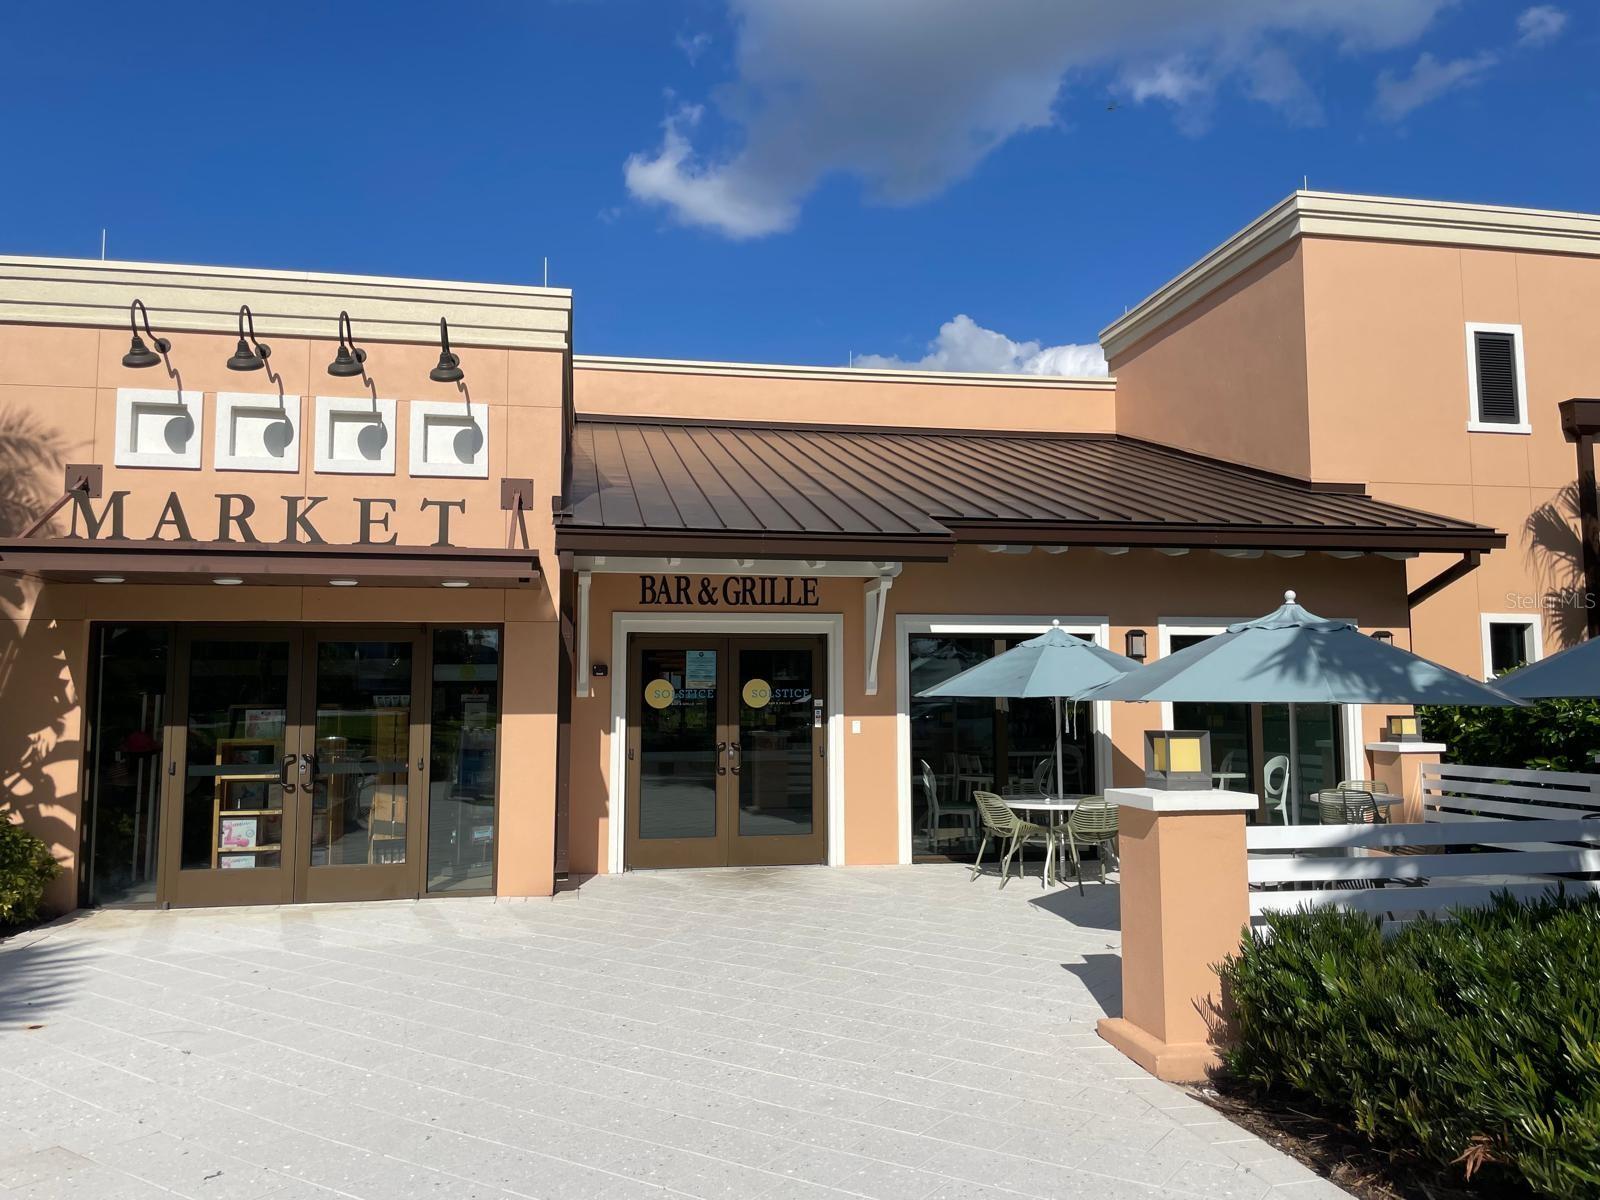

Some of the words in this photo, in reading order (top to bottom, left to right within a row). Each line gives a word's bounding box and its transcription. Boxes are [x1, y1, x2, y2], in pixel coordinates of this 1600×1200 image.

[66, 490, 466, 547] MARKET
[639, 575, 693, 604] BAR
[697, 577, 718, 605] &
[722, 576, 819, 606] GRILLE
[654, 689, 714, 699] SOLSTICE
[751, 688, 810, 698] SOLSTICE
